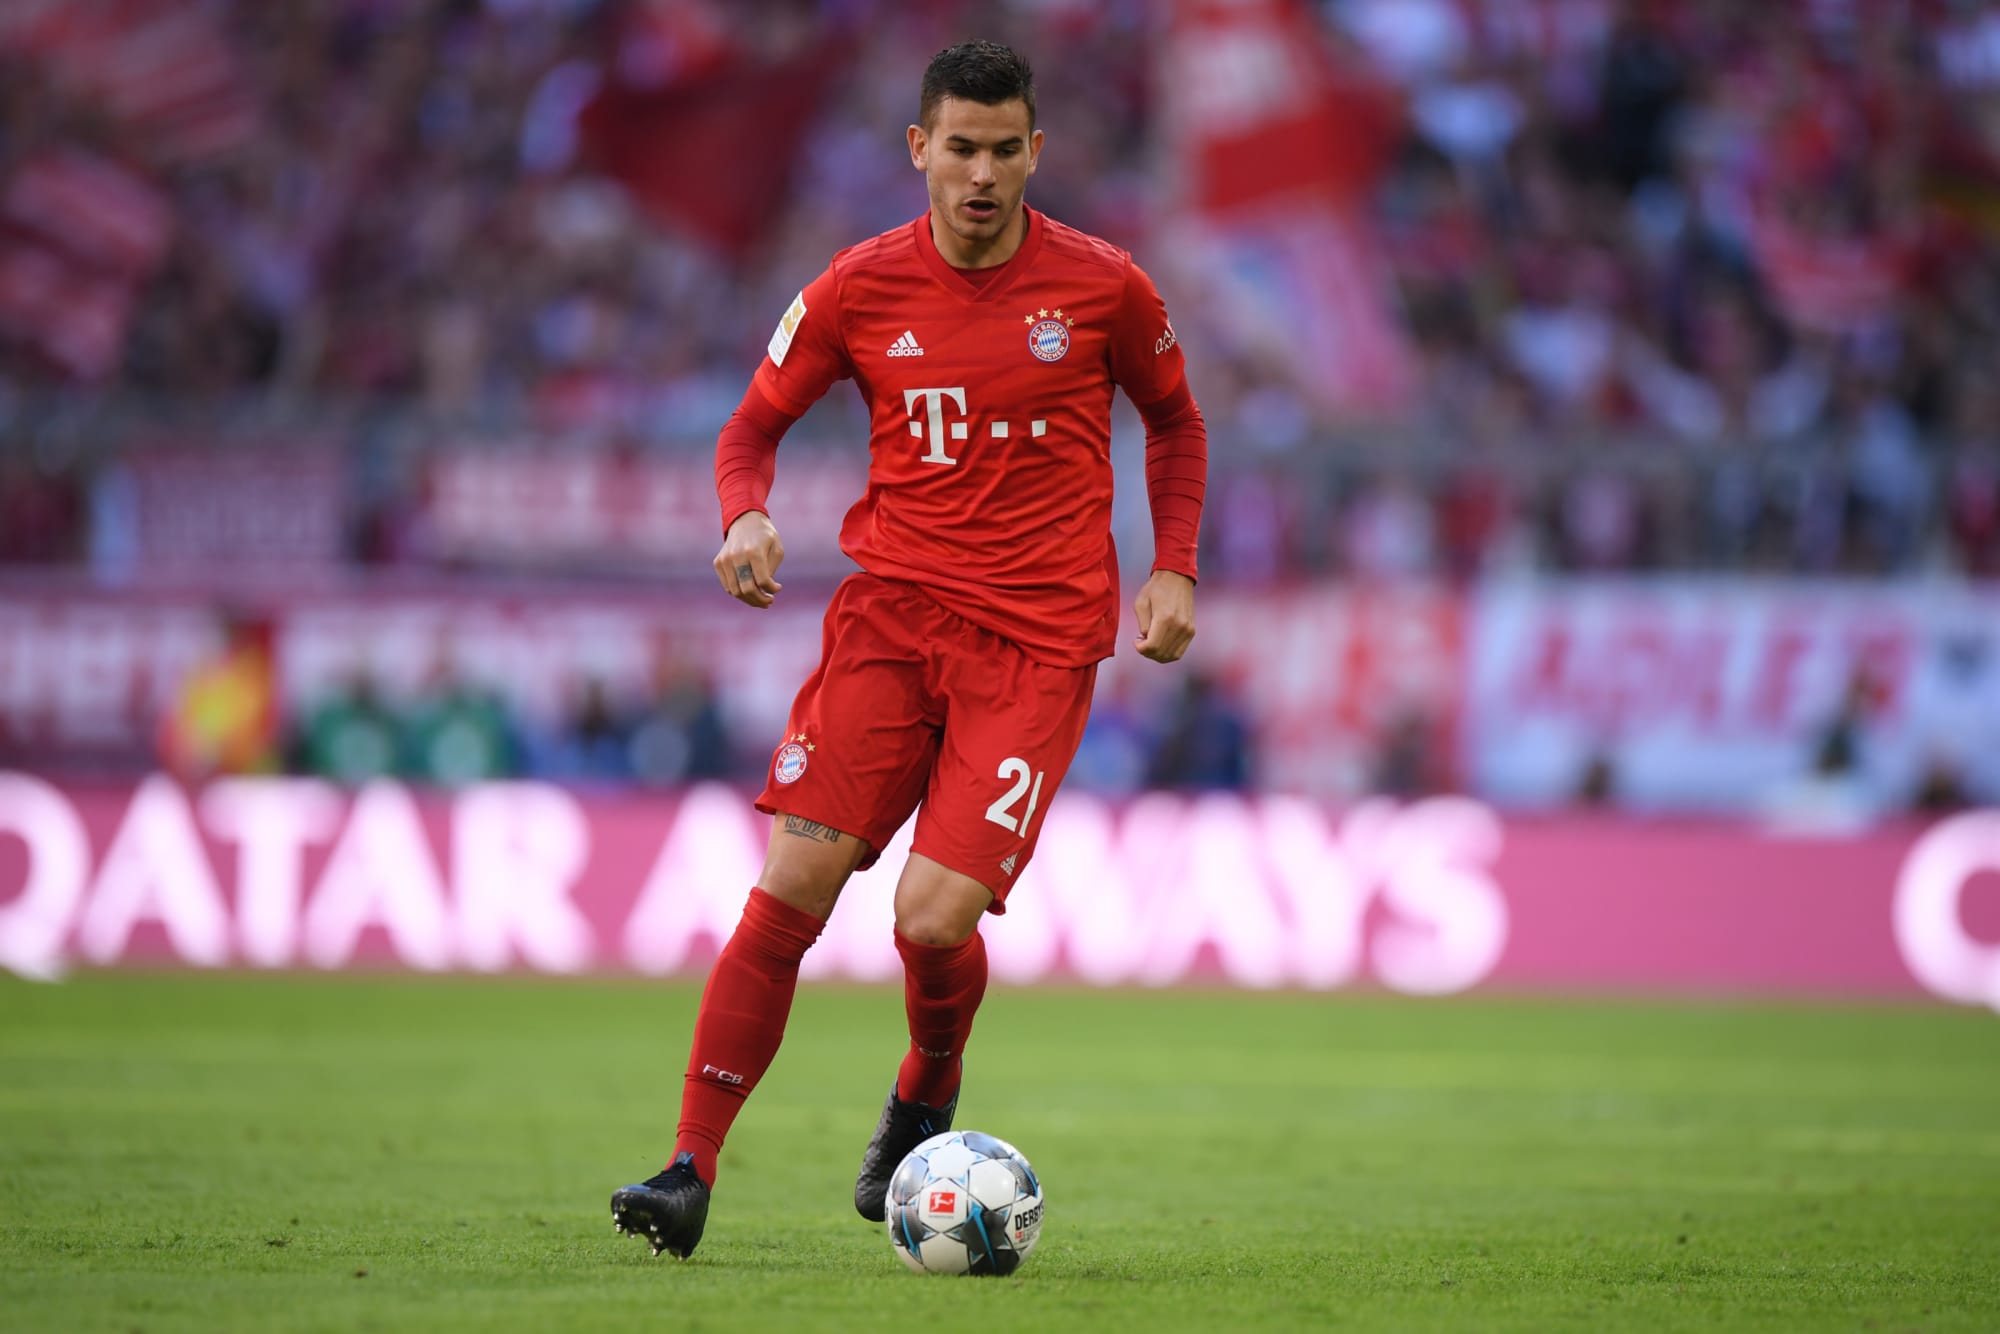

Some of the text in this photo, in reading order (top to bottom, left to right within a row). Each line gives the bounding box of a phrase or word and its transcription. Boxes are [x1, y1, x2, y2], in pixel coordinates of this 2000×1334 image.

[887, 346, 924, 357] adidas
[624, 784, 1508, 992] AWAYS
[702, 1064, 744, 1085] FCB
